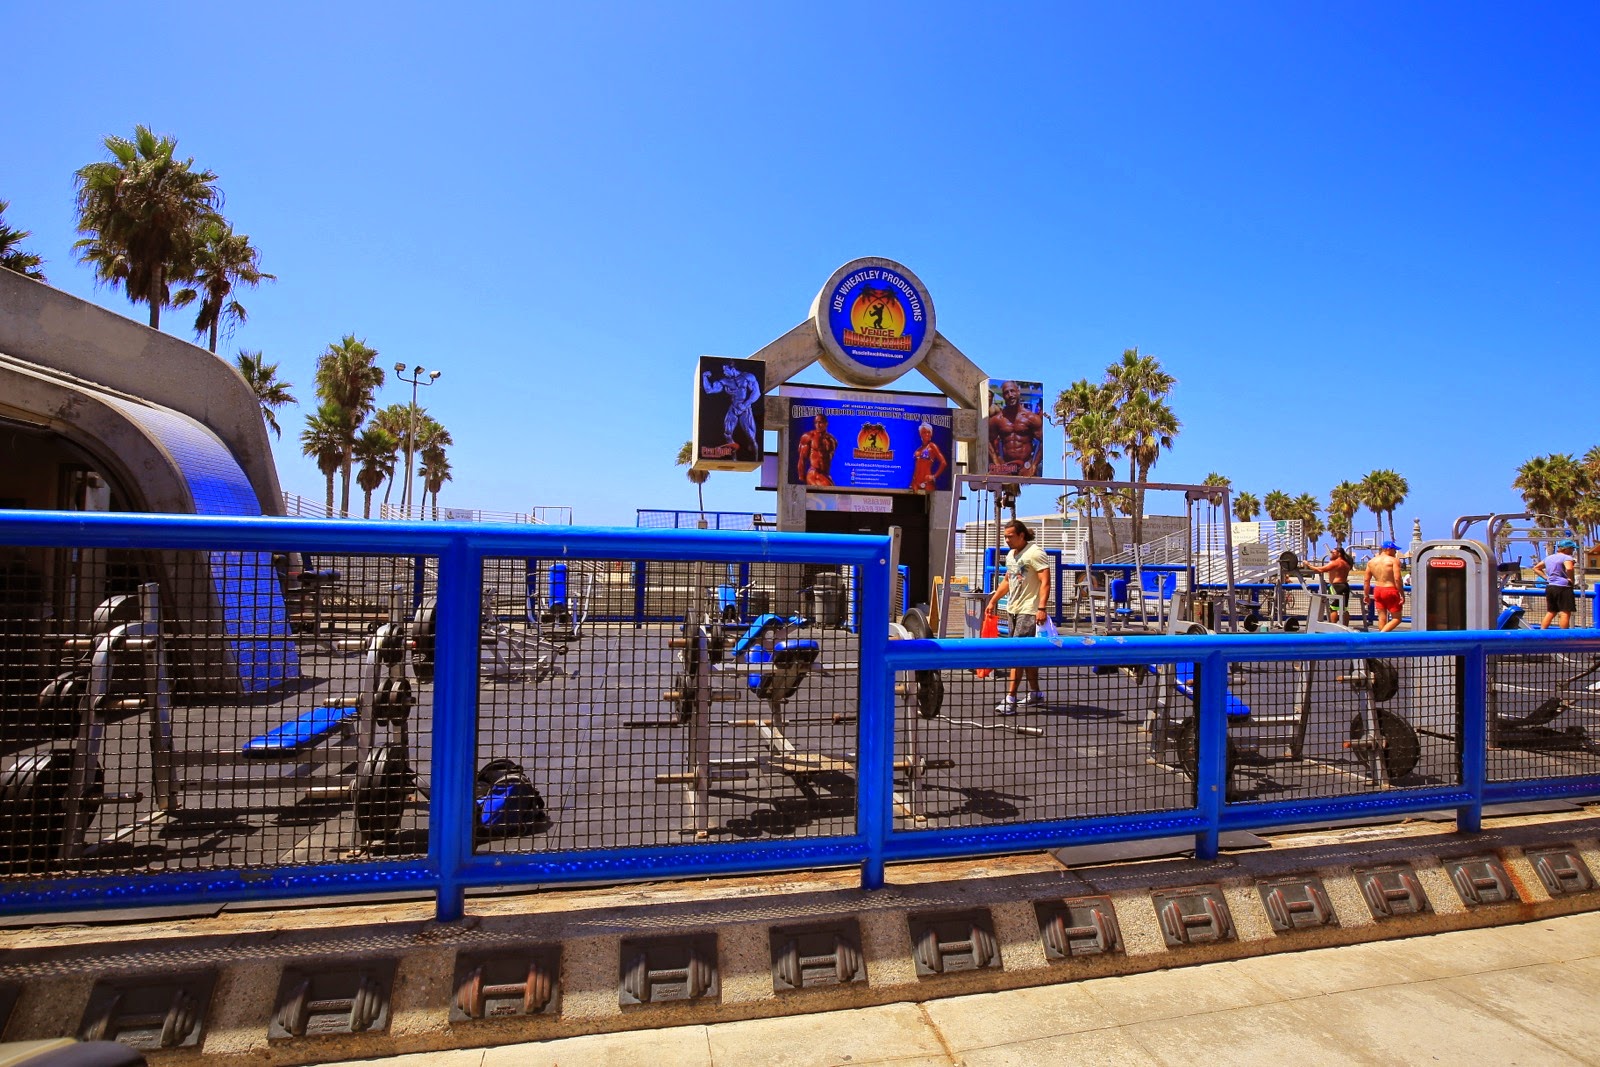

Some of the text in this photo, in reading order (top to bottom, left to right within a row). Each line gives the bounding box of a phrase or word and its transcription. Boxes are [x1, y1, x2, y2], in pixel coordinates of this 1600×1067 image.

[833, 270, 923, 322] JOE WHEATLEY PRODUCTIONS
[843, 328, 912, 352] MUSCLE BEACH
[860, 327, 895, 338] VENICE
